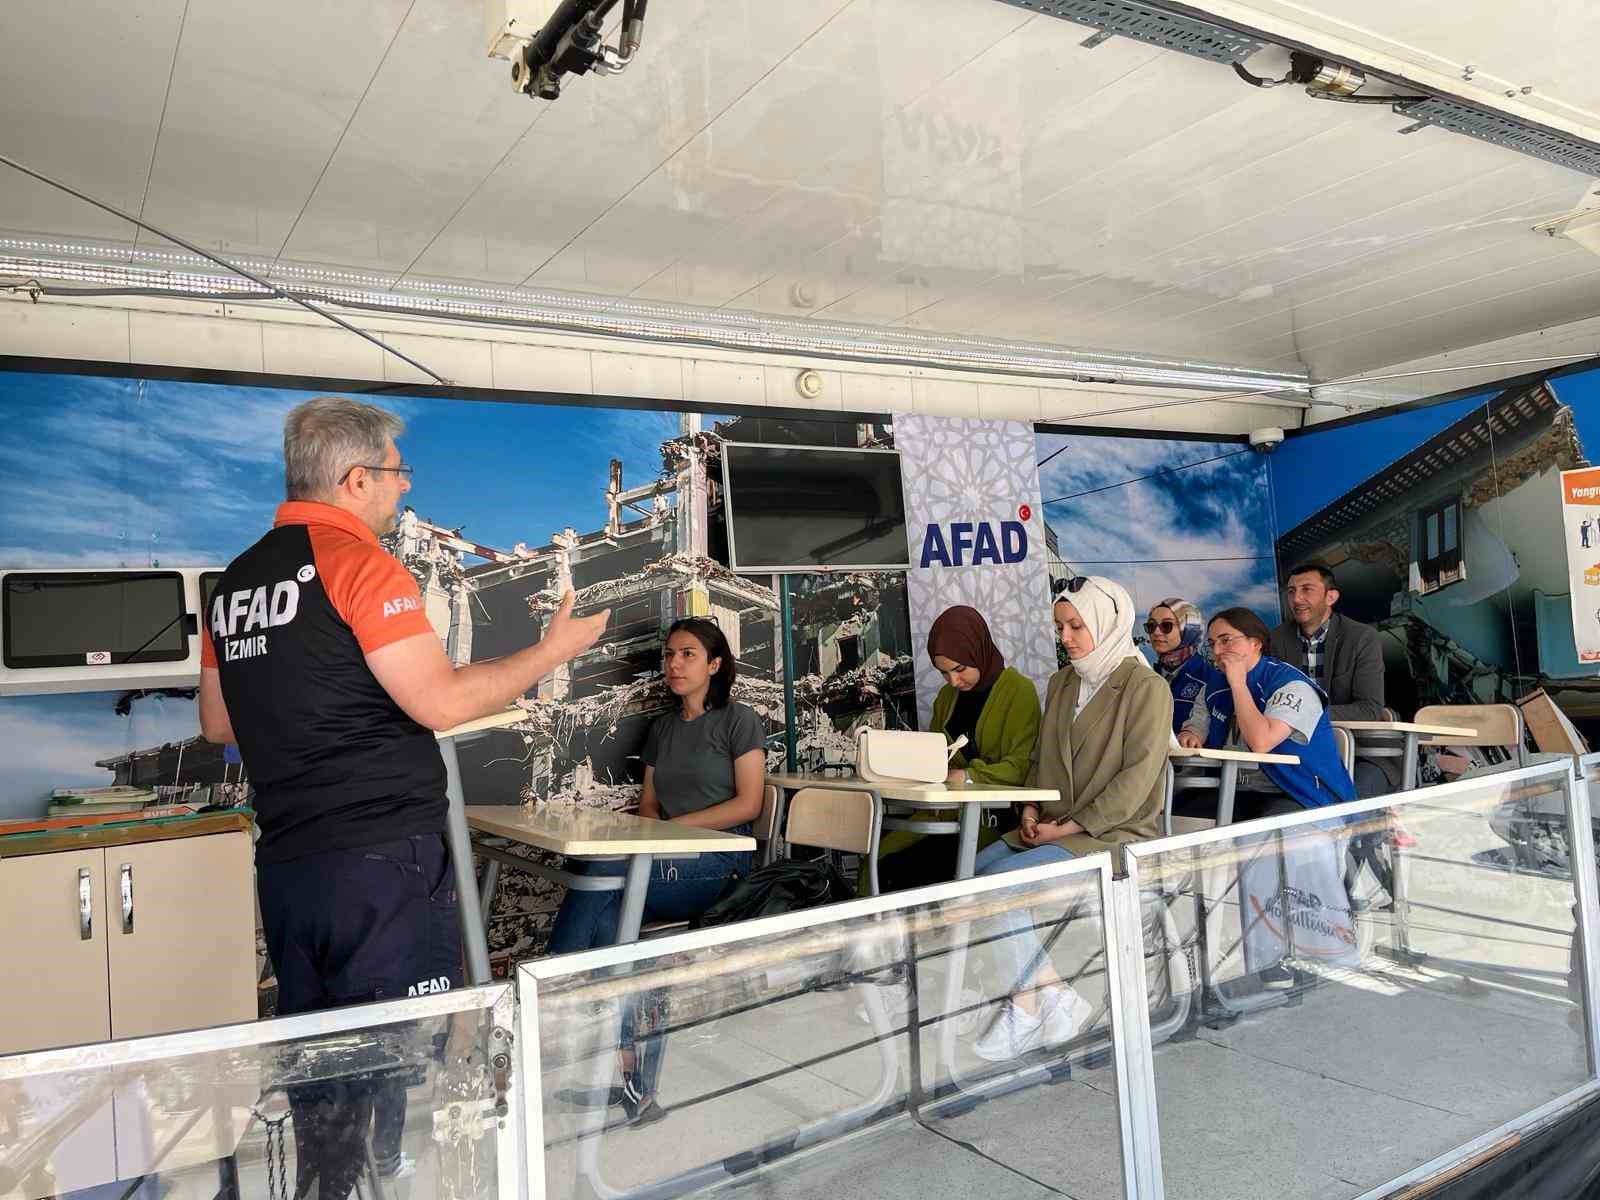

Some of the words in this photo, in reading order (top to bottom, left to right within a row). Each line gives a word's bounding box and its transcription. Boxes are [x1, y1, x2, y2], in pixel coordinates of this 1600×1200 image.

[1572, 487, 1600, 499] Yangı
[920, 521, 1028, 568] AFAD
[212, 580, 300, 640] AFAD
[408, 976, 450, 996] AFAD
